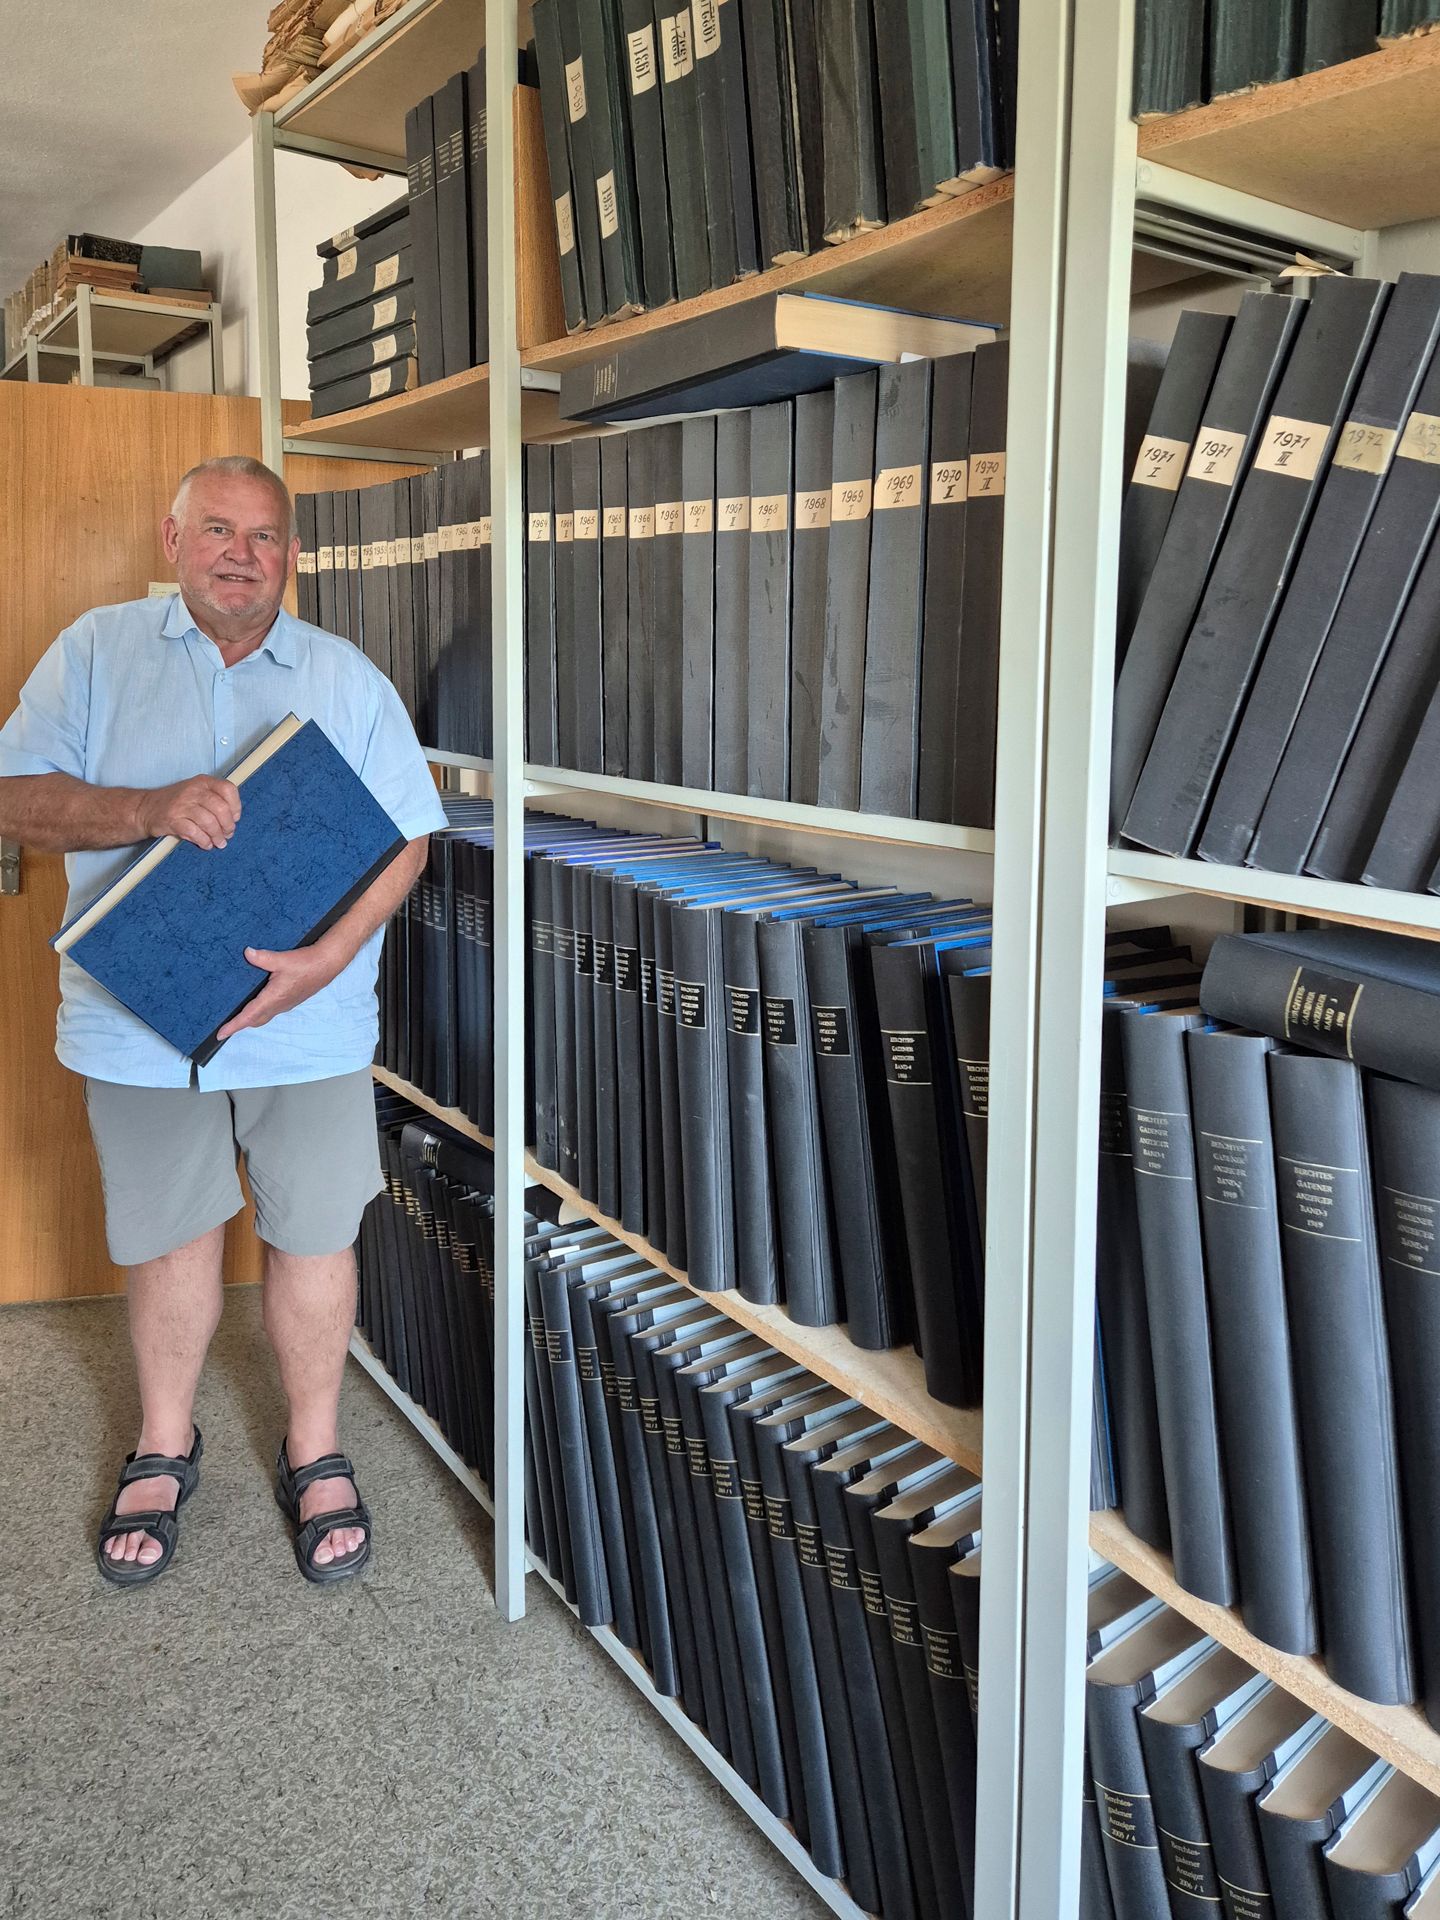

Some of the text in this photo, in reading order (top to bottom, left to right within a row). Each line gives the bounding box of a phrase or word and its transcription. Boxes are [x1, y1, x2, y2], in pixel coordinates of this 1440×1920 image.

[632, 37, 651, 80] 1931 II
[1273, 430, 1311, 449] 1971
[1347, 429, 1384, 446] 1972
[1144, 447, 1176, 463] 1971
[1200, 440, 1233, 458] 1971
[1274, 451, 1292, 466] III
[975, 460, 999, 474] 1970
[1147, 466, 1161, 478] I
[1203, 461, 1216, 474] II
[886, 474, 914, 490] 1969
[936, 468, 962, 483] 1970
[979, 476, 993, 491] II
[841, 489, 864, 503] 1969
[943, 484, 956, 499] I
[725, 503, 743, 514] 1967
[758, 504, 778, 515] 1968
[804, 497, 827, 509] 1968
[660, 510, 679, 520] 1966
[689, 505, 706, 516] 1967
[580, 516, 596, 525] 1965
[633, 514, 651, 523] 1966
